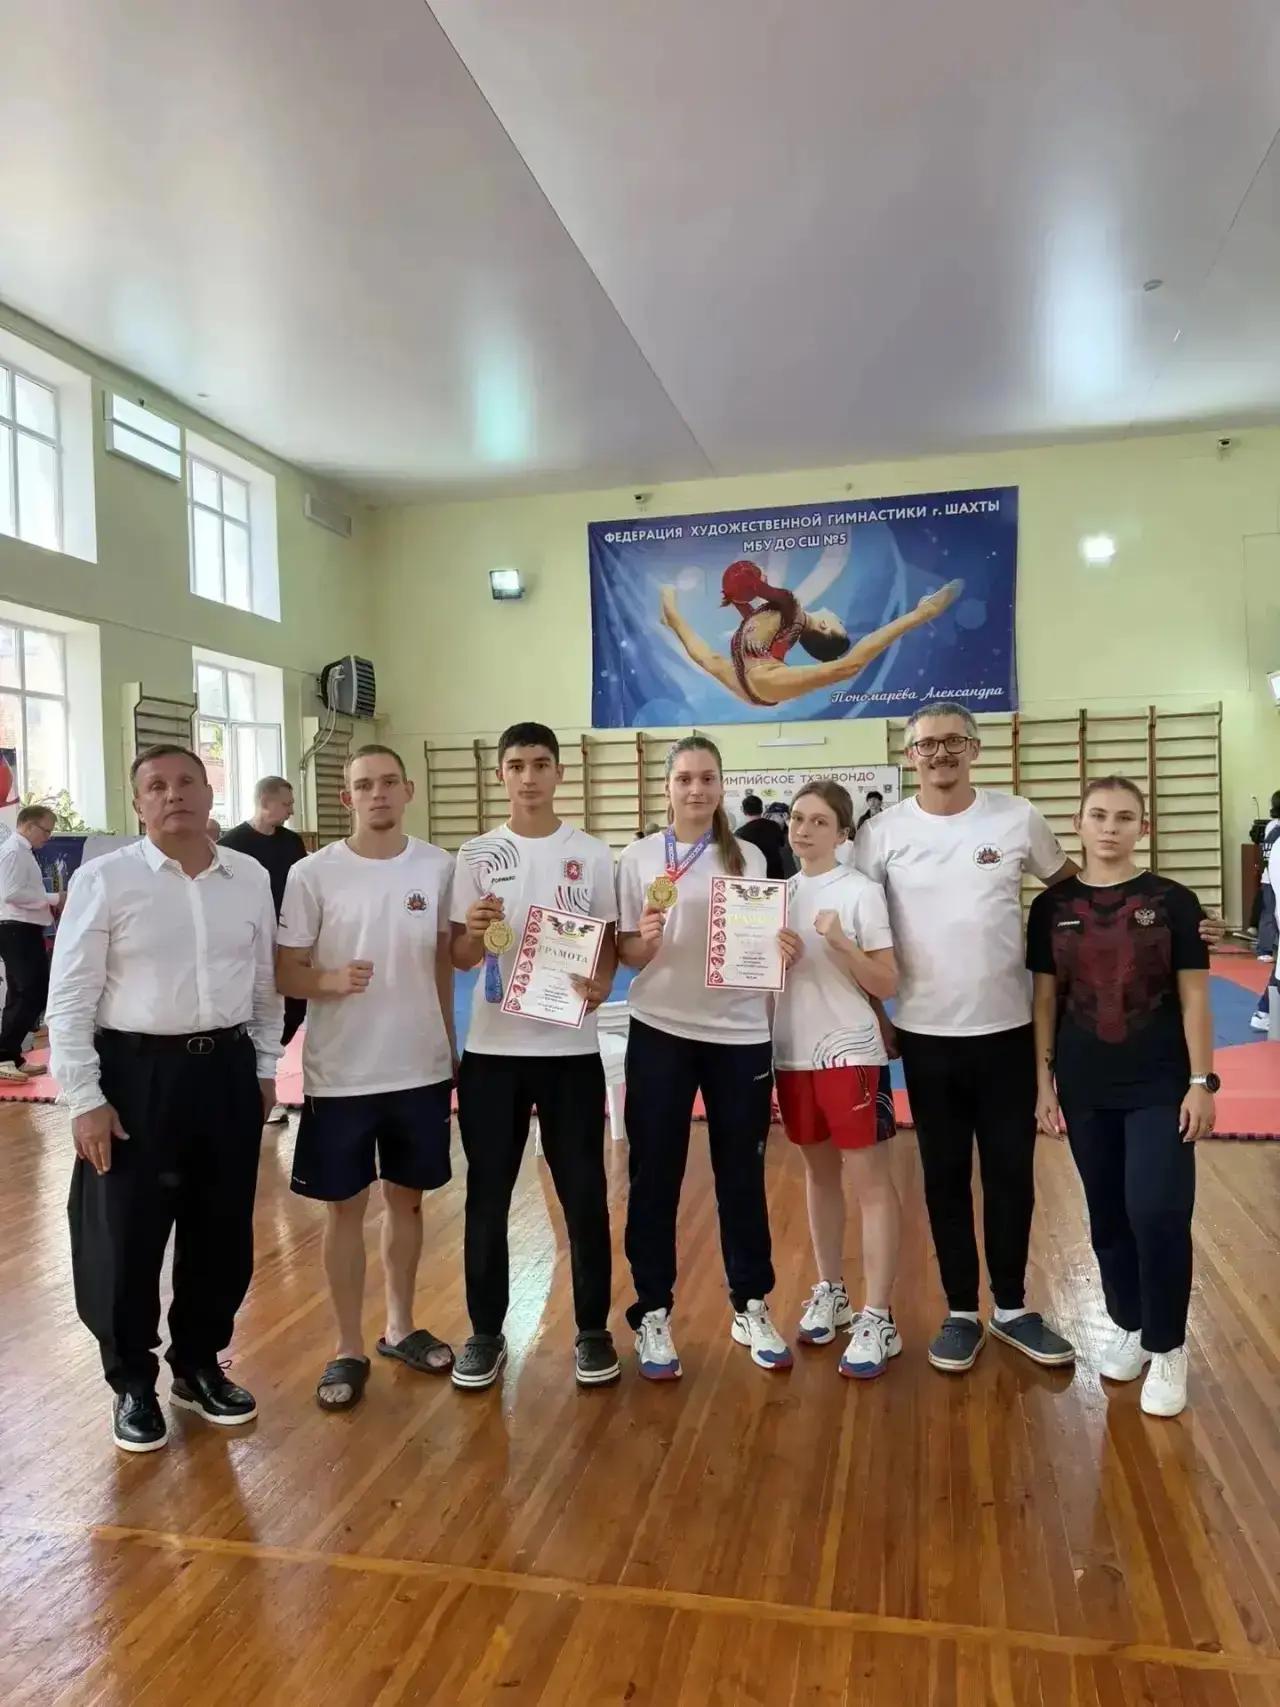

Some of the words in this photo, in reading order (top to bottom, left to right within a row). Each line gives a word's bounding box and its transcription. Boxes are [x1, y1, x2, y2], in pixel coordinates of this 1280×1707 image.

[604, 526, 683, 544] ФЕДЕРАЦИЯ
[690, 513, 822, 537] ХУДОЖЕСТВЕННОЙ
[828, 506, 927, 526] ГИМНАСТИКИ
[932, 508, 943, 517] г.
[945, 500, 1000, 516] ШАХТЫ
[743, 540, 772, 553] МБУ
[774, 537, 796, 551] ДО
[798, 536, 820, 548] СШ
[823, 533, 847, 545] №5
[831, 688, 919, 704] Пономарёва
[920, 686, 1004, 701] Александра
[538, 944, 589, 964] ГРАМОТА
